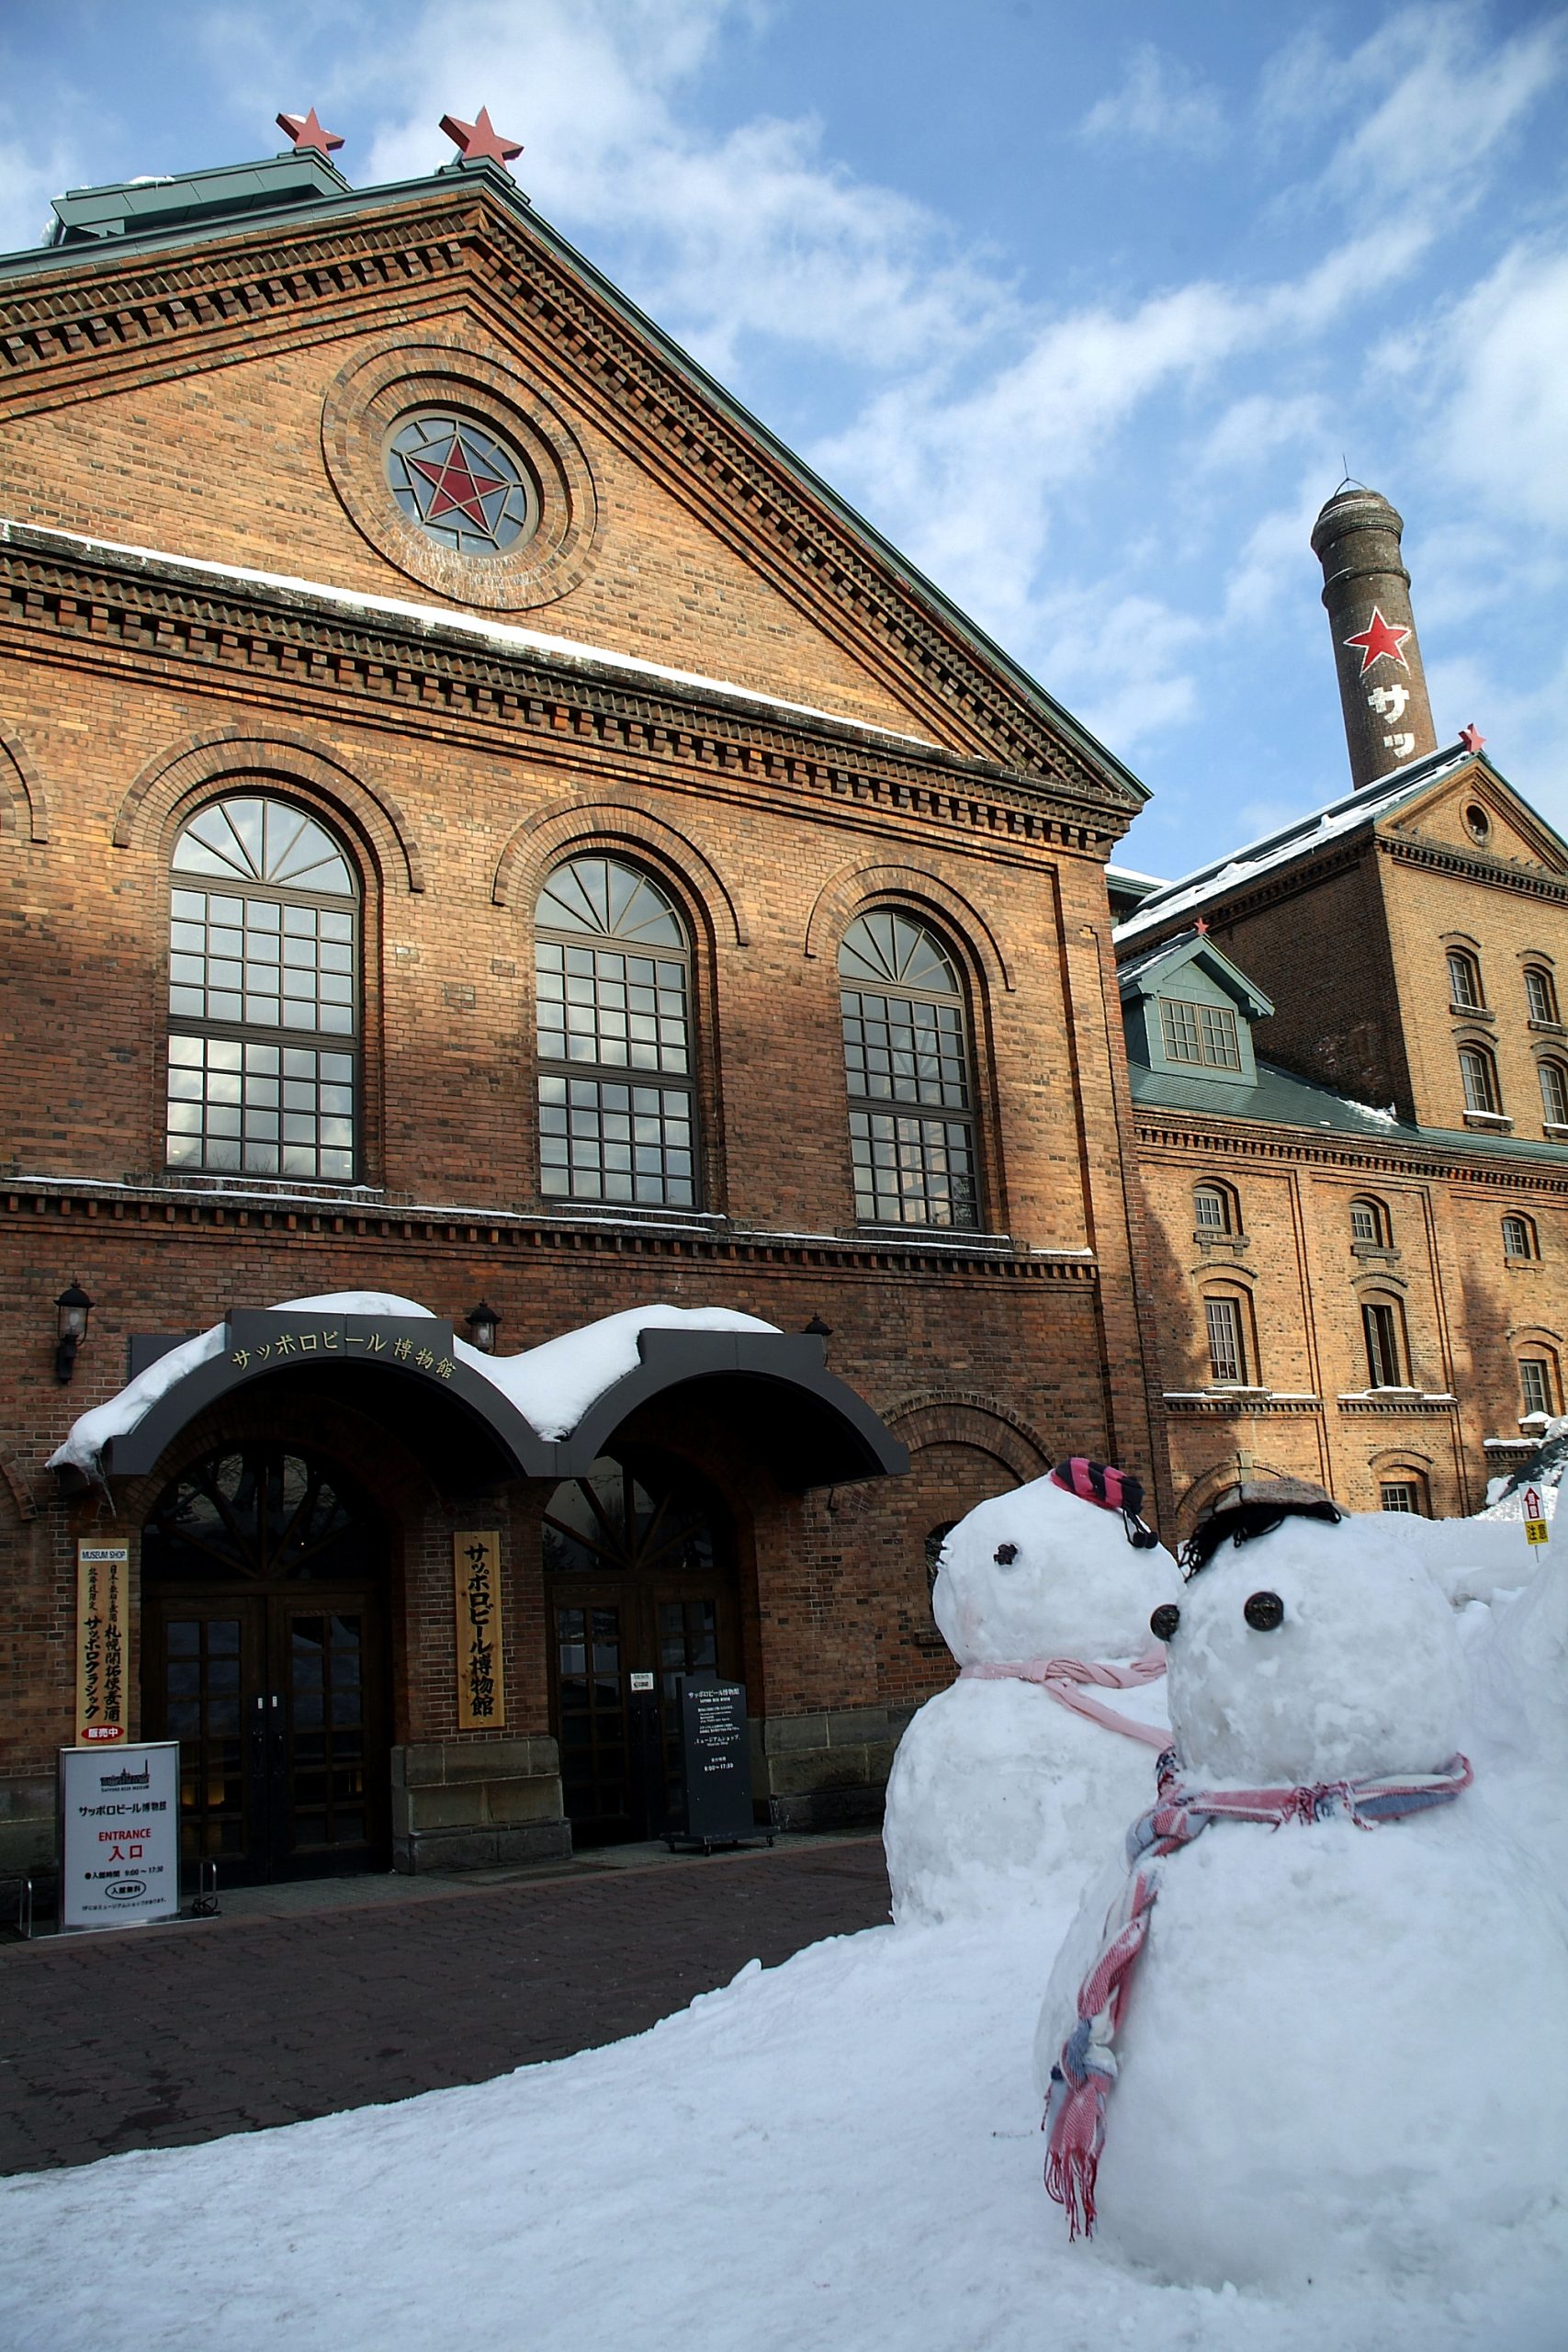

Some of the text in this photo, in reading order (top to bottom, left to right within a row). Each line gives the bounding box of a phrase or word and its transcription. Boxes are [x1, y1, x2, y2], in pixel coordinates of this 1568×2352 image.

[82, 1550, 126, 1559] MUSEUM SHOP
[464, 1543, 494, 1716] サッポロビール博物館
[79, 1801, 167, 1816] サッポロビール博物館
[98, 1827, 152, 1842] ENTRANCE
[107, 1844, 143, 1861] 入口
